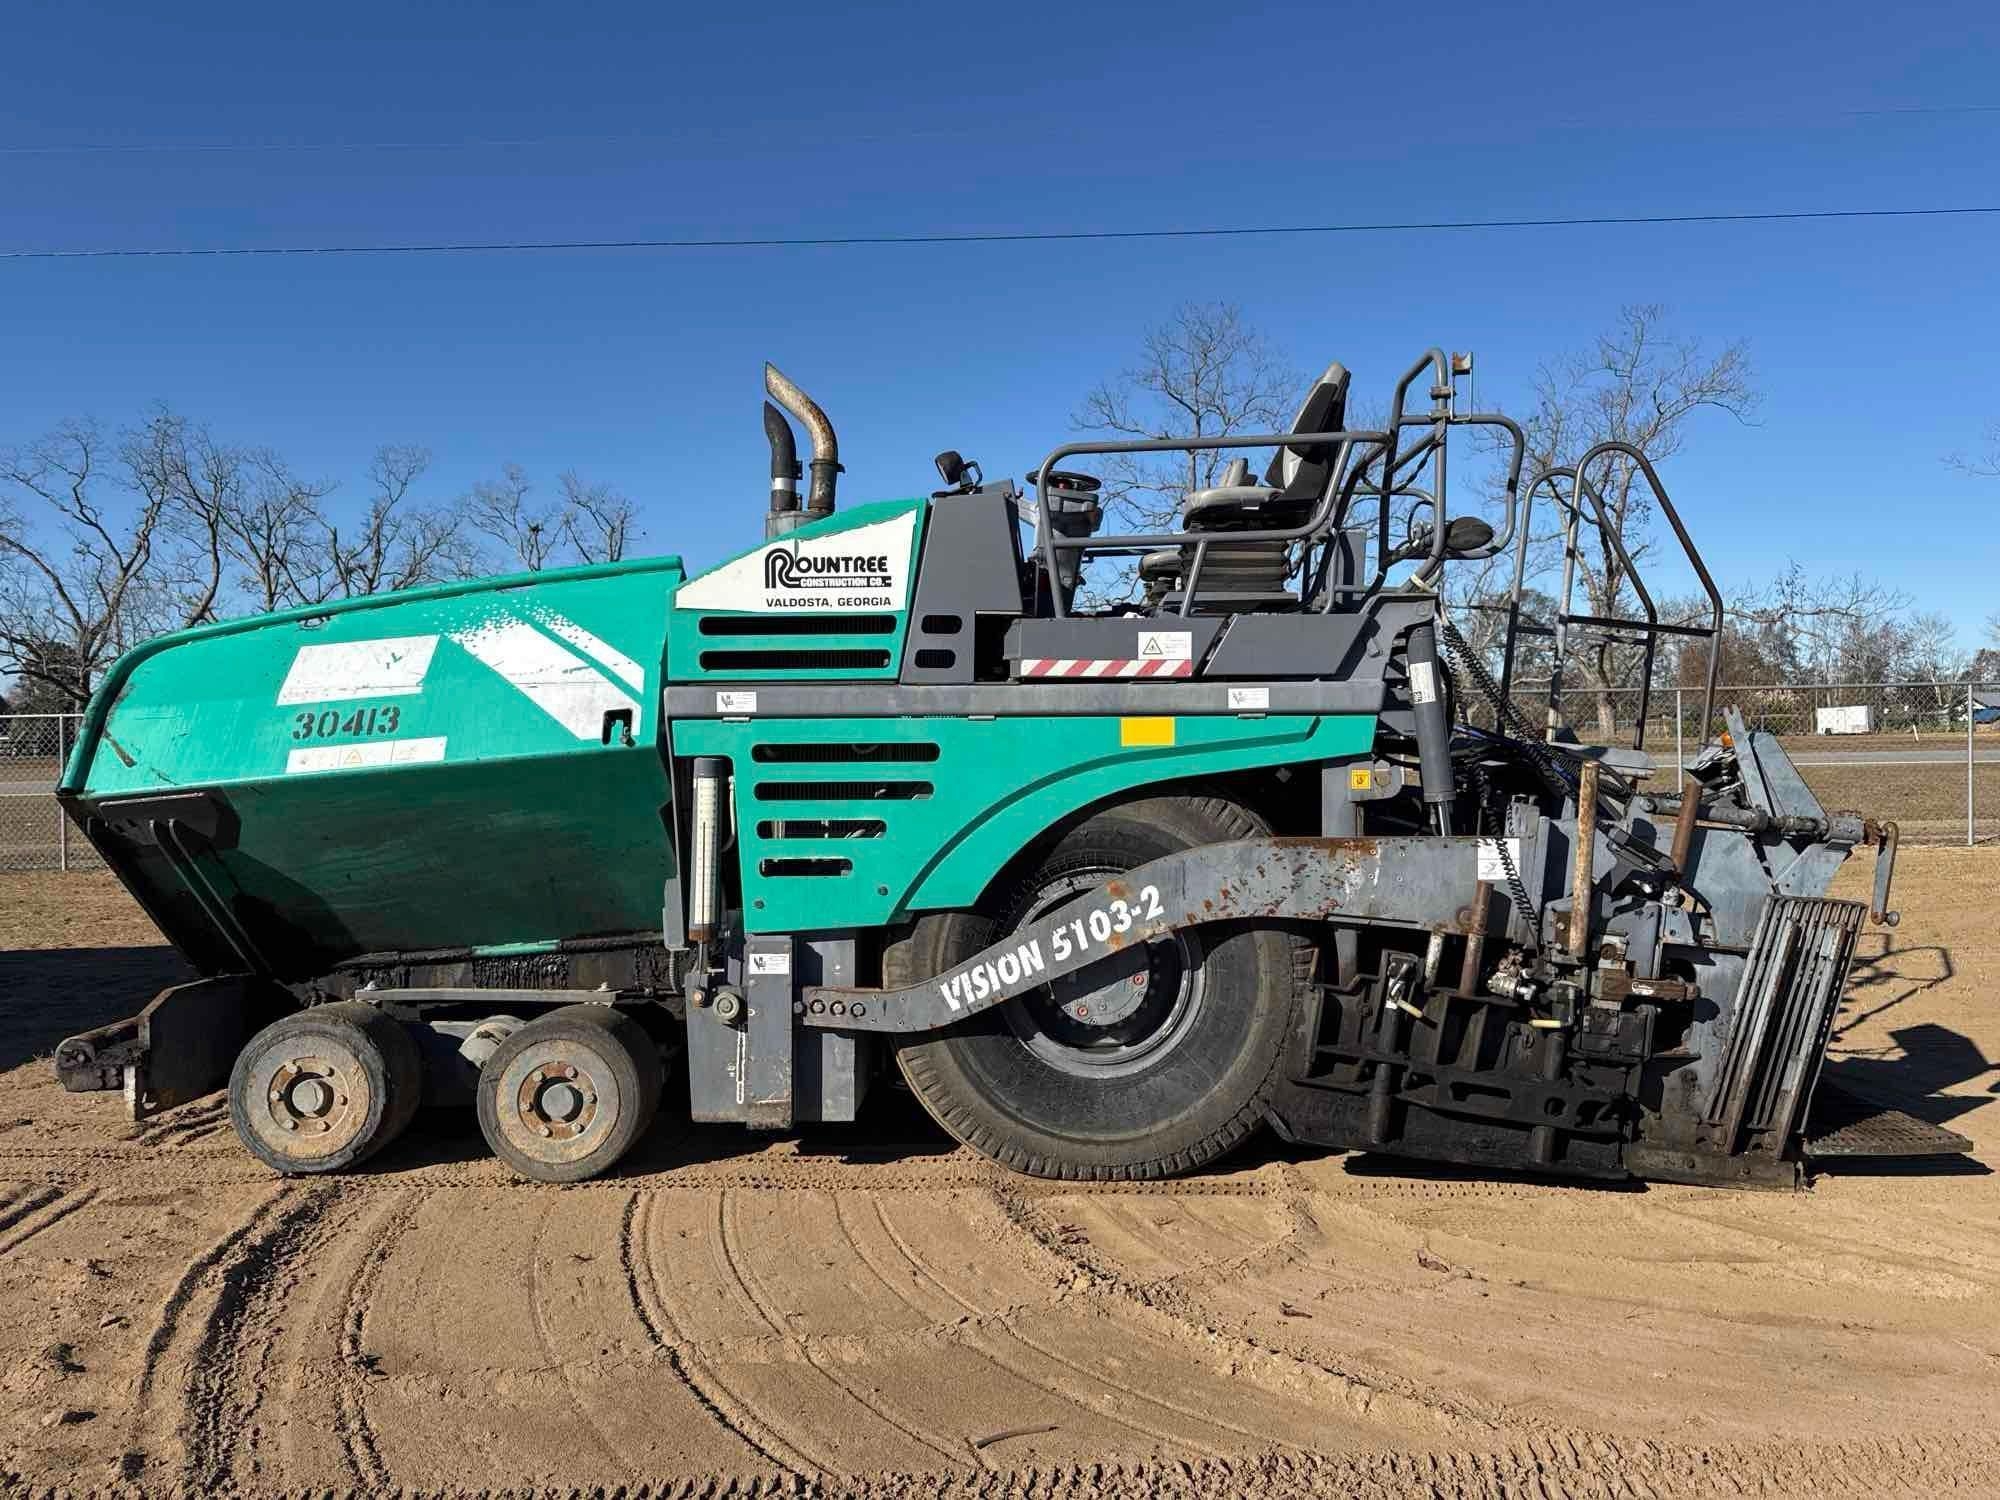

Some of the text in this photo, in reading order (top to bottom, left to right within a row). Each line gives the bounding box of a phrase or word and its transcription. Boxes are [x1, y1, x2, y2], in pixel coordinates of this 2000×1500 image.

[764, 547, 888, 588] ROUNTREE
[800, 577, 868, 587] CONSTRUCTION
[766, 597, 891, 608] VALDOSTA, GEORGIA
[292, 706, 401, 740] 30413
[939, 885, 1164, 1012] VISION 5103-2
